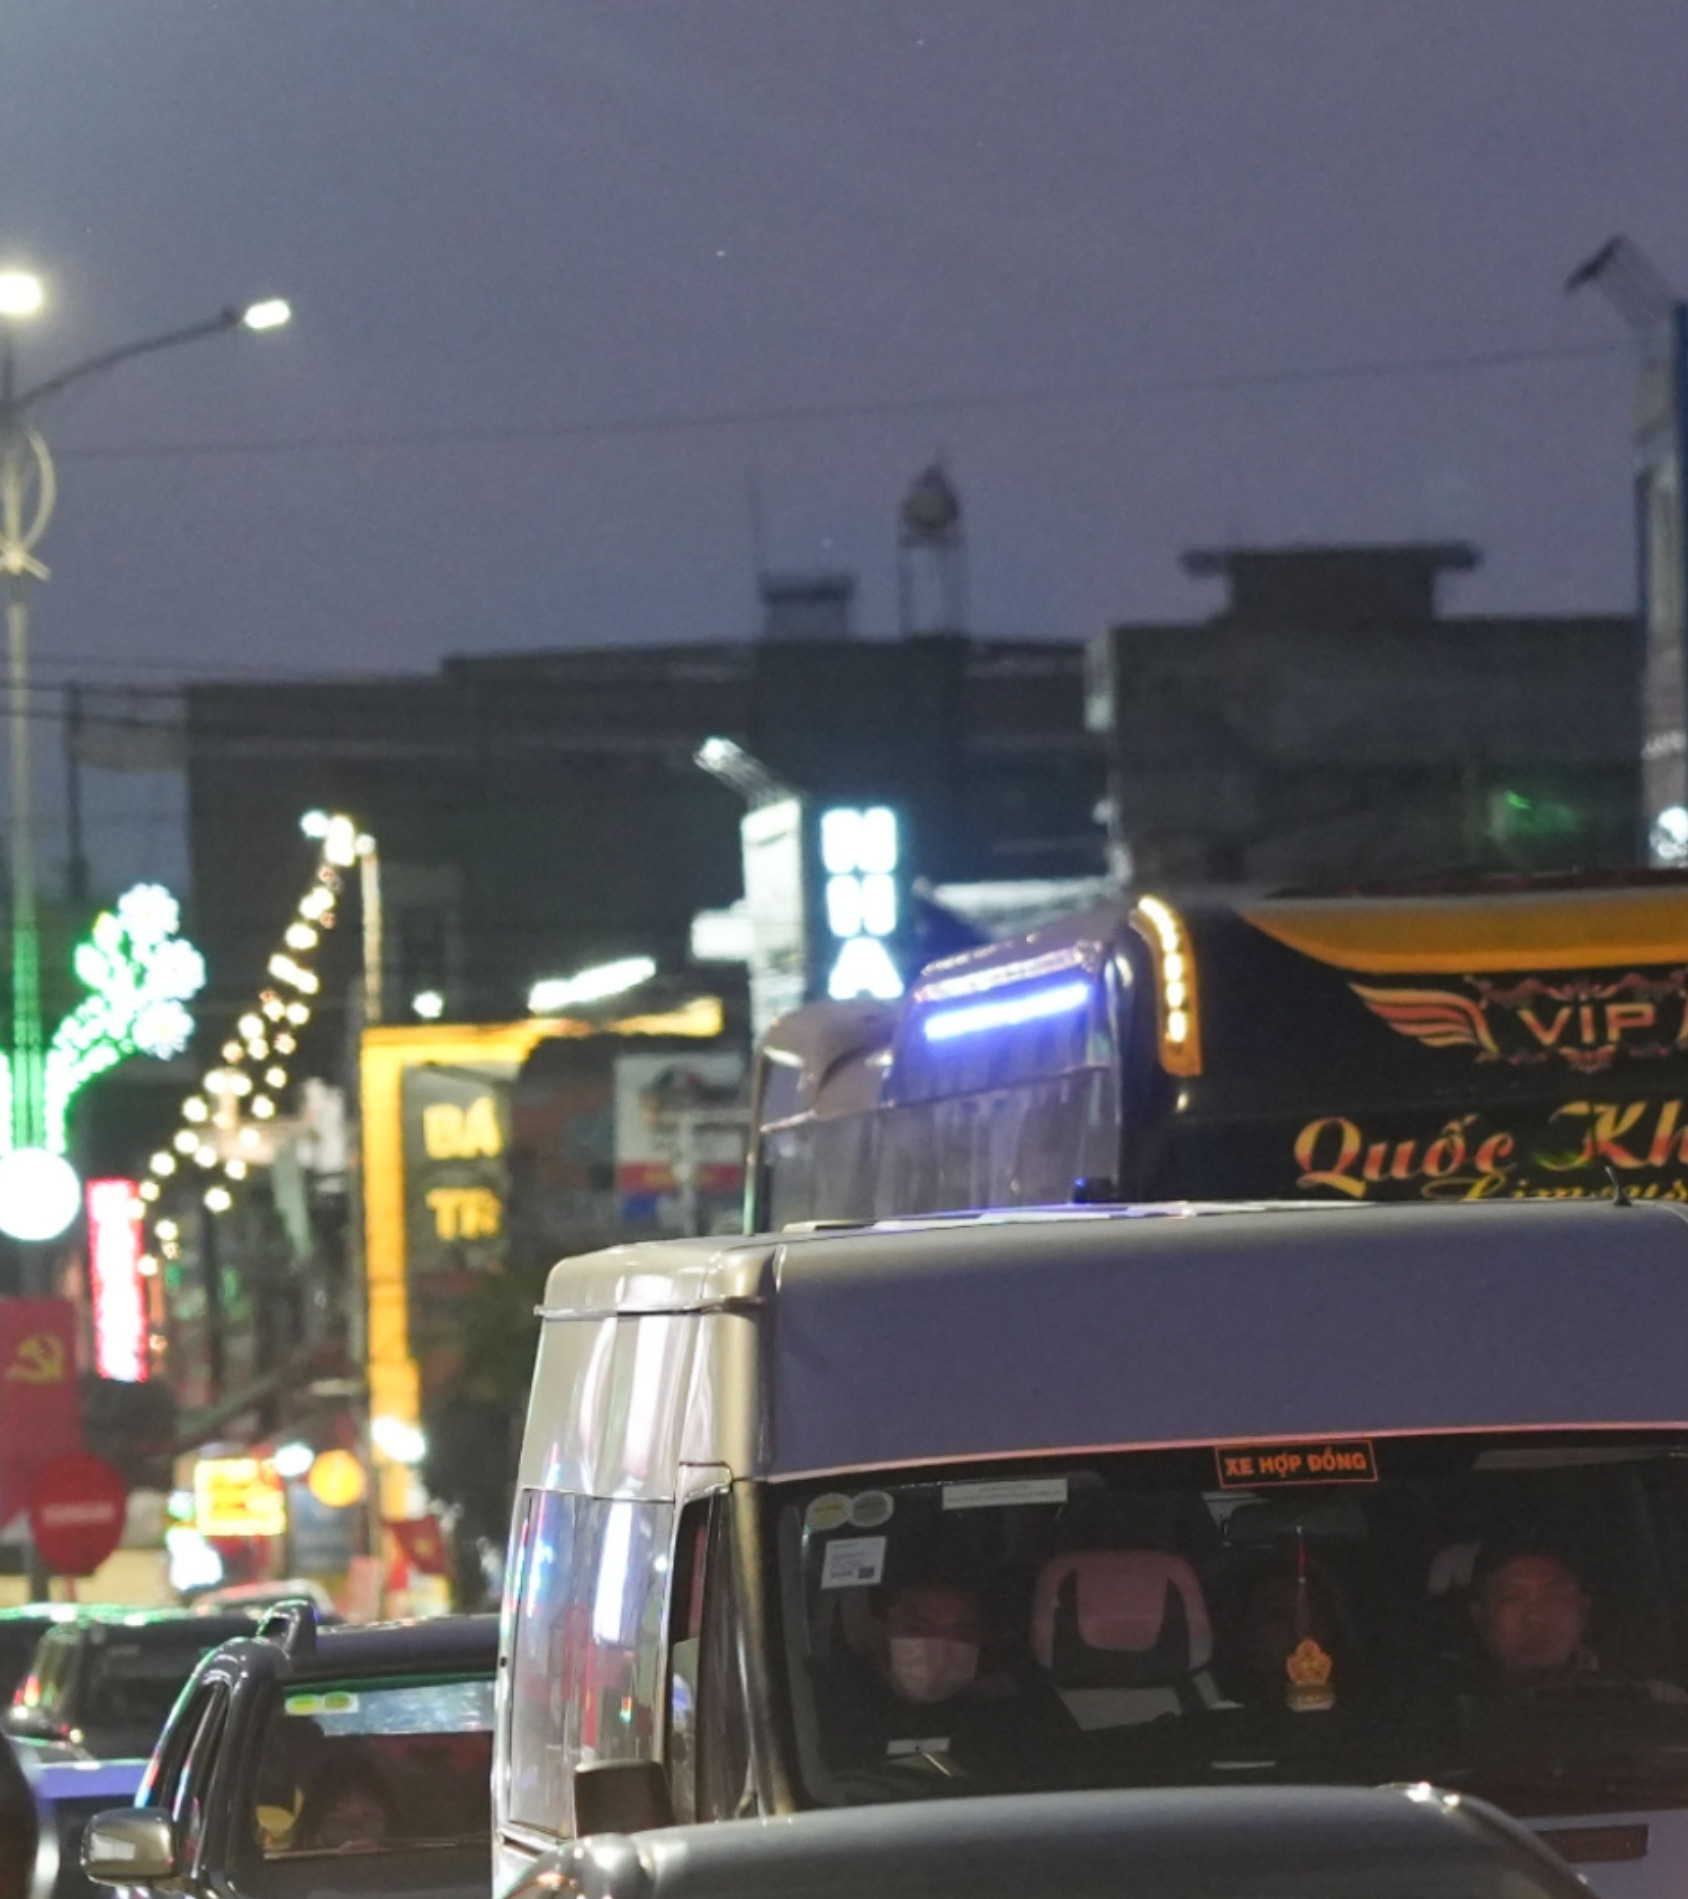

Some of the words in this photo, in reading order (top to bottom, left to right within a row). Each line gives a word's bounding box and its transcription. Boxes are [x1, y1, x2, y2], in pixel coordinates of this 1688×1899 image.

[1518, 1003, 1656, 1046] VIP
[1295, 1112, 1518, 1199] Quốc
[1224, 1458, 1255, 1477] XE
[1259, 1451, 1302, 1479] HỢP
